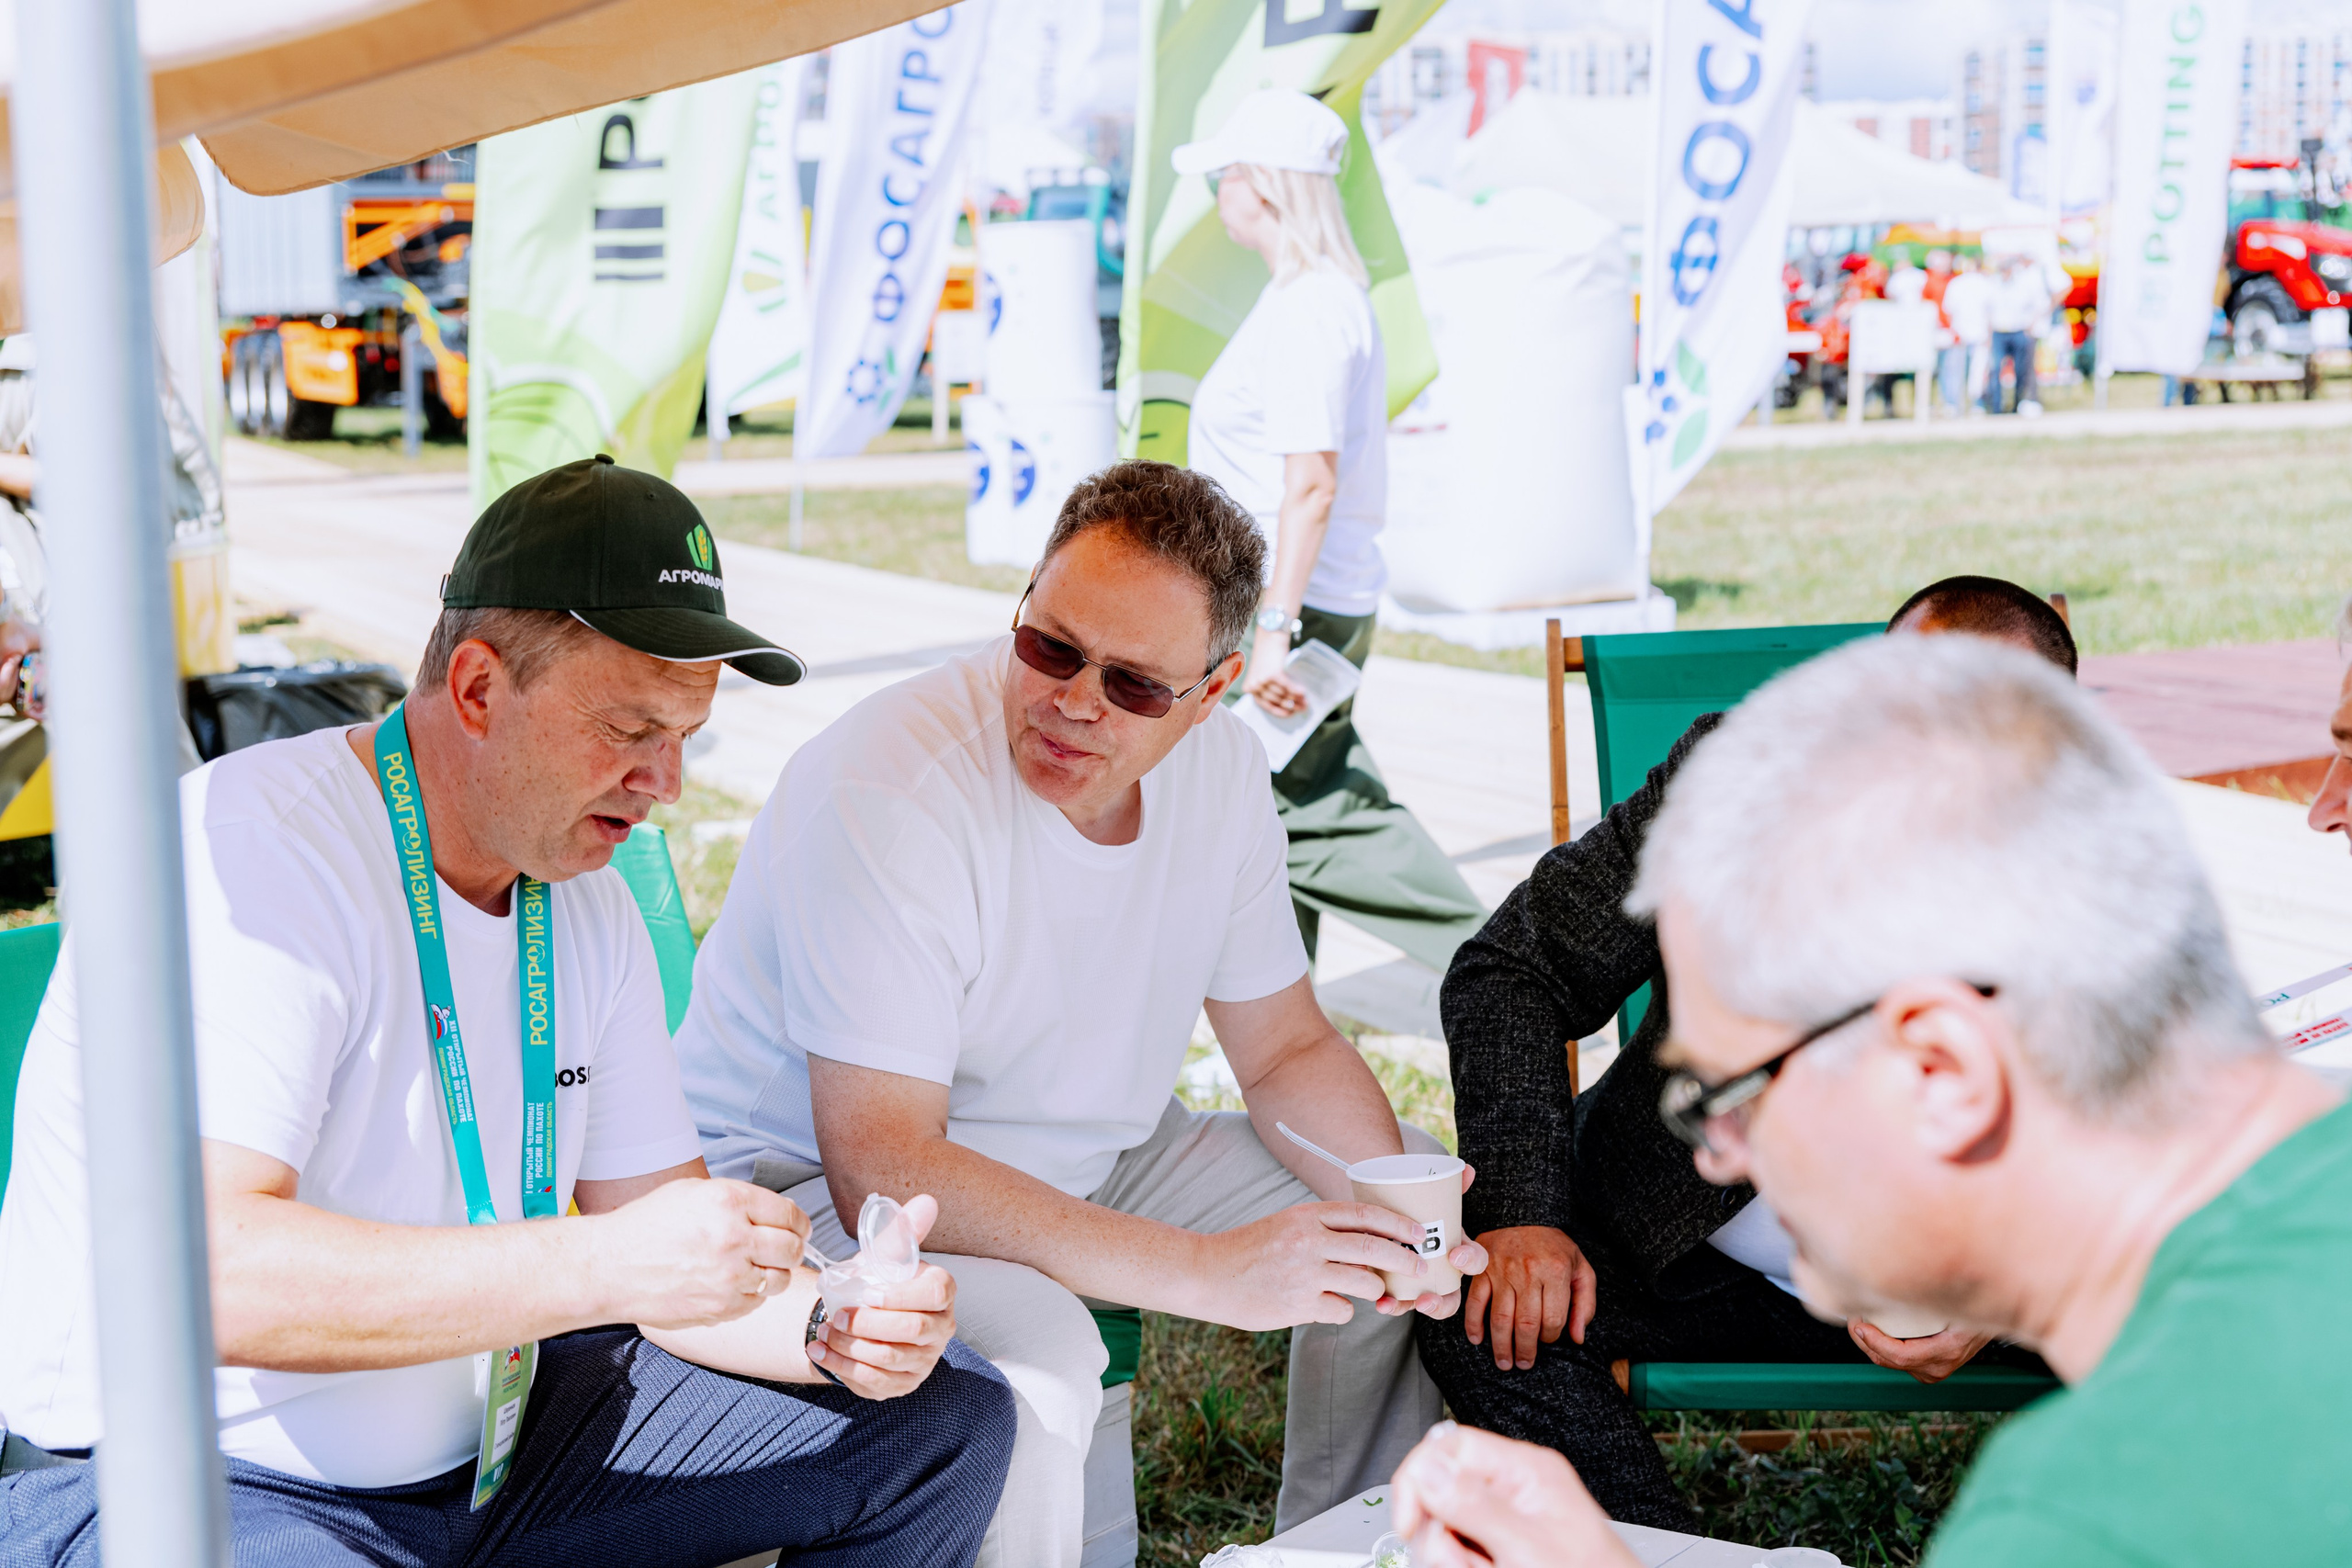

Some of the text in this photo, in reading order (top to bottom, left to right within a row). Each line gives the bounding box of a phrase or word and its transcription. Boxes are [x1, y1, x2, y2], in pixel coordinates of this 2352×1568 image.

[382, 751, 437, 940] РОСАГРОЛИЗИНГ
[438, 1047, 458, 1125] ЛЕНИНГРАДСКАЯ ОБЛАСТЬ
[446, 1045, 468, 1123] РОССИИ ПО ПАХОТЕ
[451, 1033, 467, 1077] ОТКРЫТЫЙ
[460, 1077, 474, 1122] ЧЕМПИОНАТ
[555, 1066, 591, 1089] OS
[526, 1101, 535, 1145] ЧЕМПИОНАТ
[535, 1101, 545, 1179] РОССИИ ПО ПАХОТЕ
[526, 1146, 534, 1189] ОТКРЫТЫЙ
